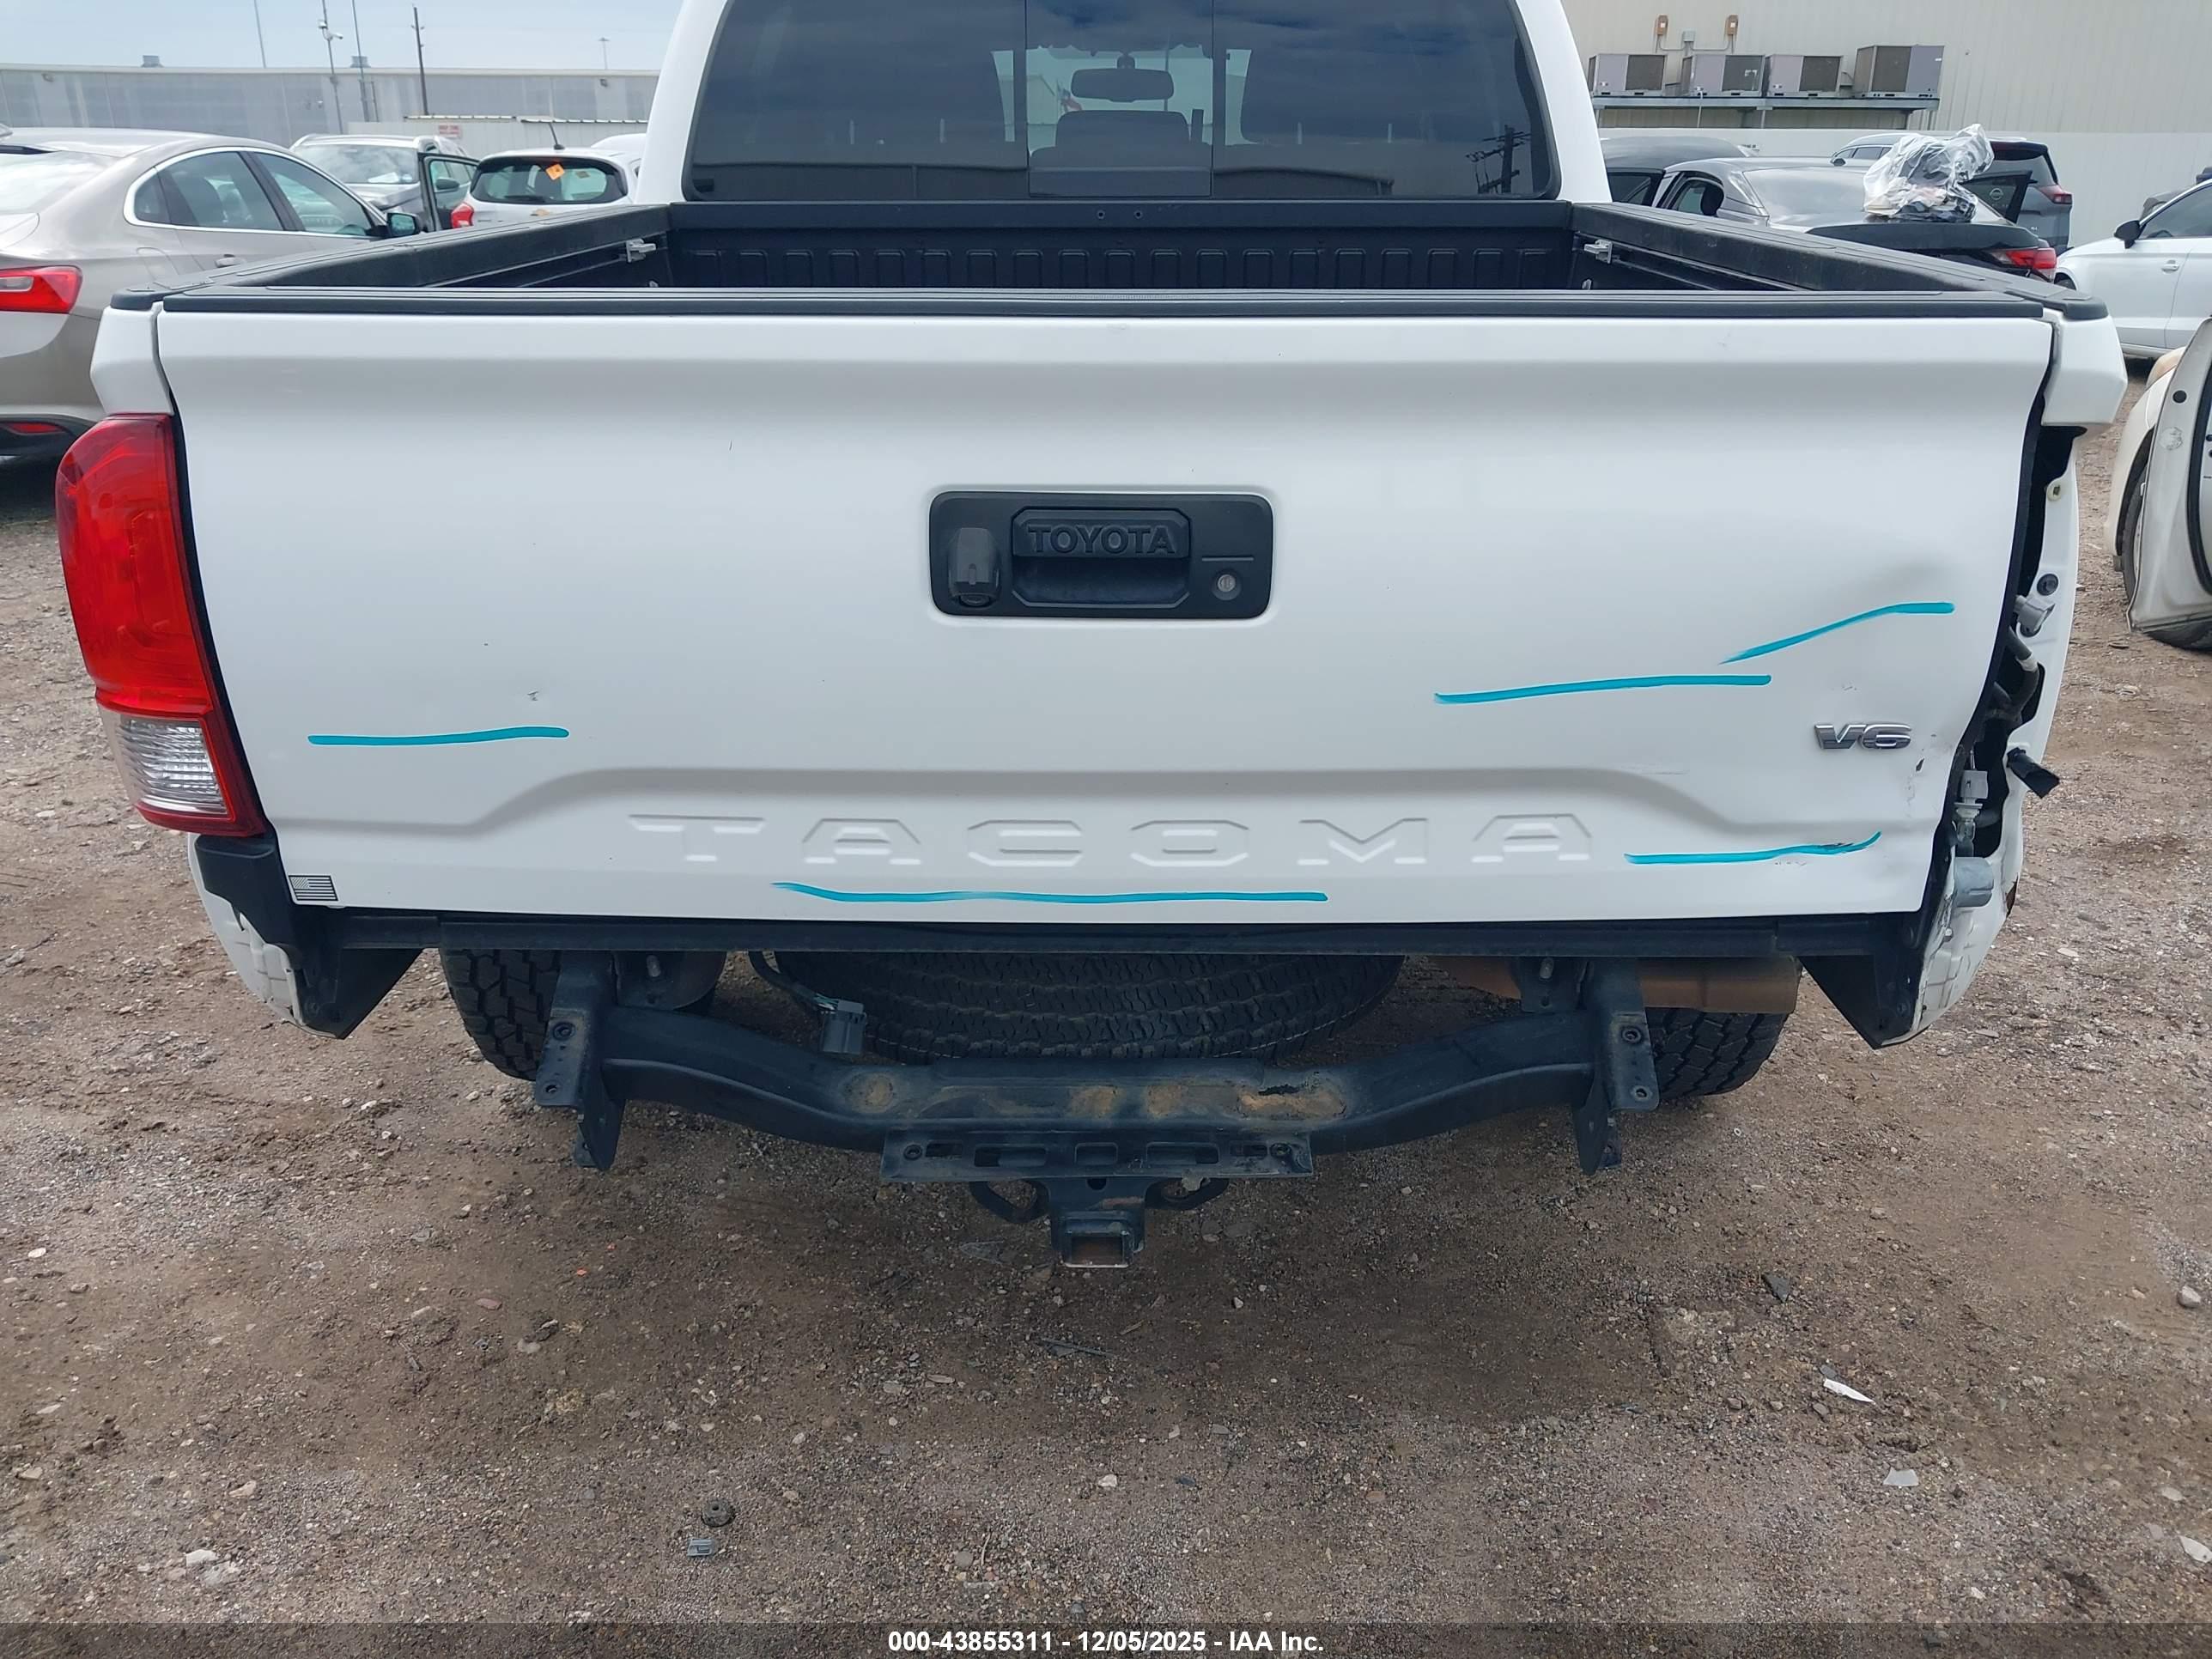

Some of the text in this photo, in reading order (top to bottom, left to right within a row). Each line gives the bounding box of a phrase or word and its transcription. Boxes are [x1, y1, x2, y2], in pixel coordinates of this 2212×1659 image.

[1027, 524, 1176, 555] TOYOTA
[1814, 723, 1912, 750] V6
[628, 813, 1593, 866] TACOMA
